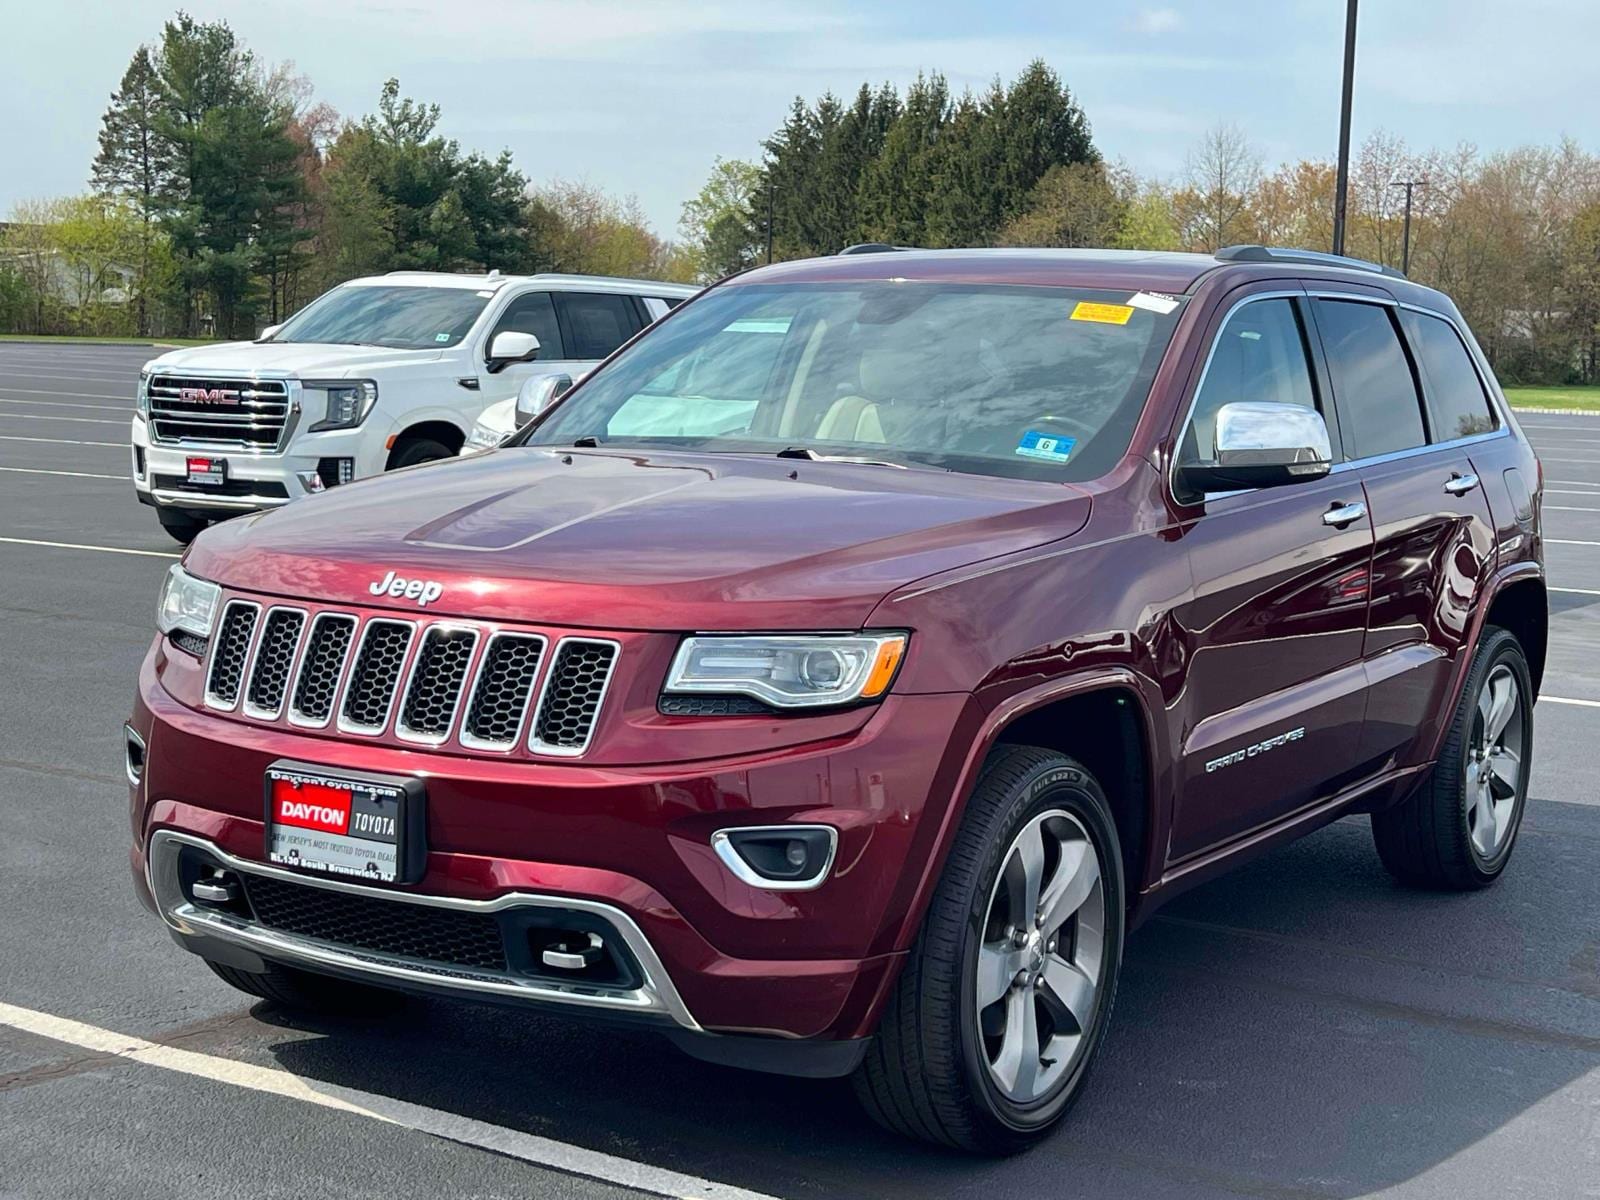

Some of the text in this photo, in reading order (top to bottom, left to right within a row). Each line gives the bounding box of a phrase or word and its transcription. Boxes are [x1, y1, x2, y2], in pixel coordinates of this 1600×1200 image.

[180, 387, 240, 405] GMC
[1042, 440, 1051, 450] 6
[369, 570, 444, 607] Jeep
[1205, 726, 1305, 773] GRAND CHEROKEE
[271, 771, 397, 797] DaytonToyota.com
[281, 800, 345, 826] DAYTON
[355, 812, 395, 836] TOYOTA
[300, 858, 327, 871] South
[355, 847, 376, 859] TOYOTA
